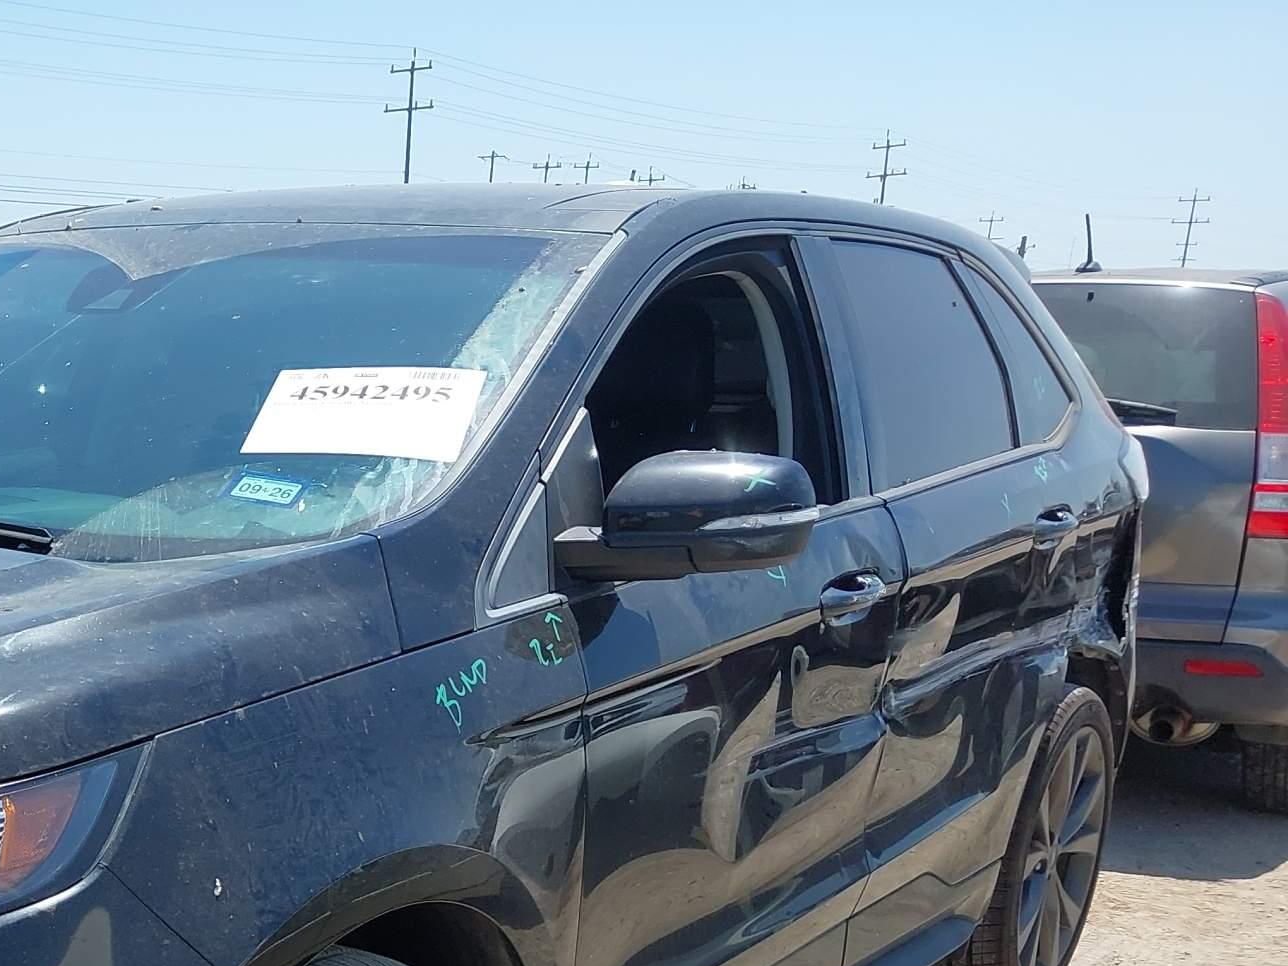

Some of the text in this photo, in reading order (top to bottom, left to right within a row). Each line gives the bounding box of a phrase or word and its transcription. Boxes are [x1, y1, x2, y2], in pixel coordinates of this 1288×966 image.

[289, 382, 453, 405] 45942495
[238, 482, 294, 499] 09 26
